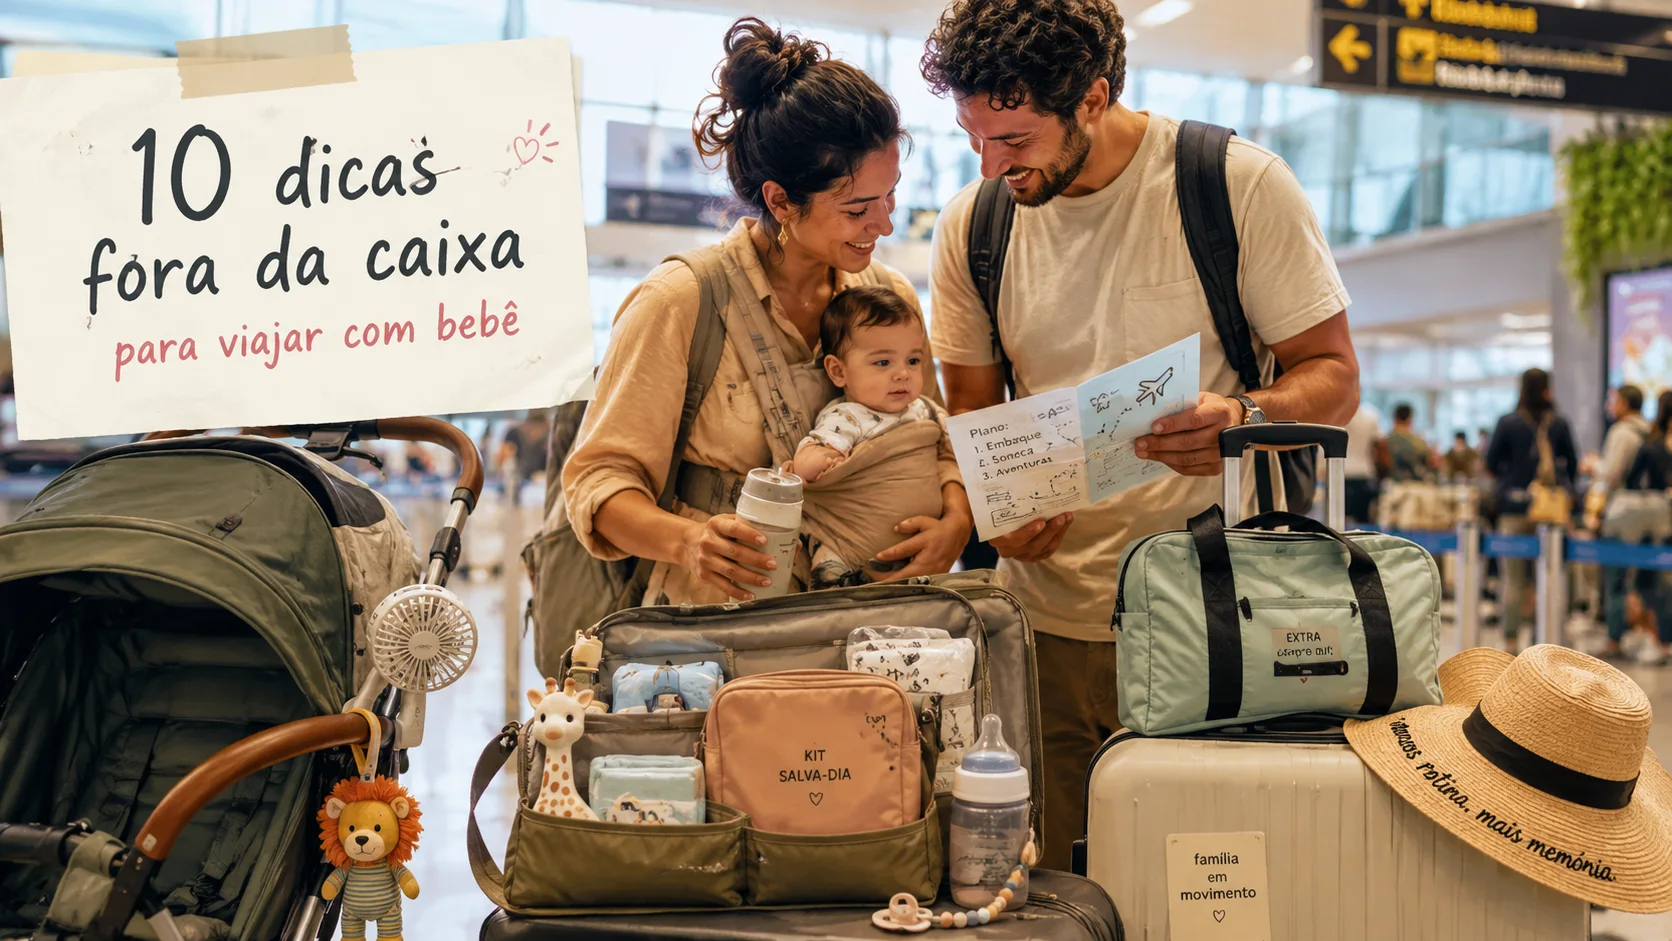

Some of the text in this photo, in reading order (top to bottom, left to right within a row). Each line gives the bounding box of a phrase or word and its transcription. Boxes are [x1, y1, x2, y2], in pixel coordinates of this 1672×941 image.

[969, 423, 1009, 439] Plano:
[1286, 632, 1322, 643] EXTRA
[804, 749, 826, 762] KIT
[779, 767, 852, 783] SALVA-DIA
[1475, 809, 1523, 843] mais
[1193, 852, 1239, 866] família
[1207, 873, 1228, 883] em
[1180, 886, 1257, 901] movimento
